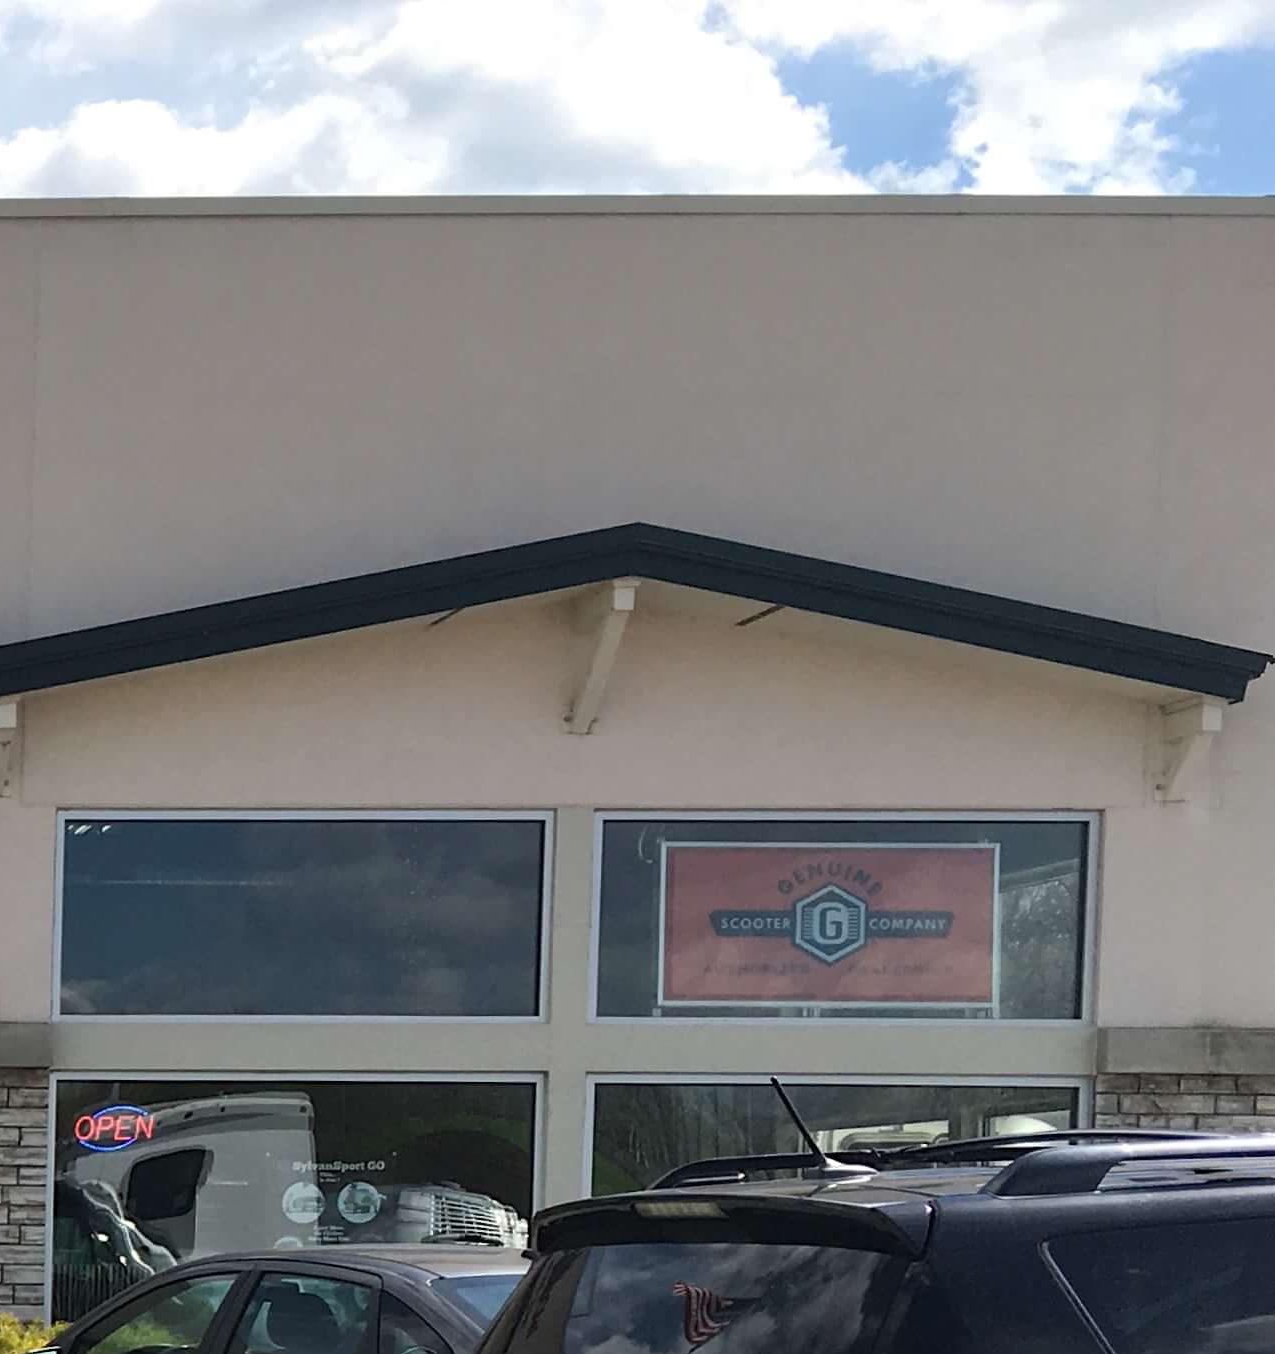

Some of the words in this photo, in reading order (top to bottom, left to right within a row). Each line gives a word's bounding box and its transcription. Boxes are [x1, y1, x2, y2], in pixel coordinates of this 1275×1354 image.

[777, 861, 883, 895] GENUINE
[720, 916, 791, 930] SCOOTER
[816, 905, 846, 942] G
[869, 917, 947, 931] COMPANY
[75, 1115, 154, 1141] OPEN
[367, 1161, 386, 1170] GO
